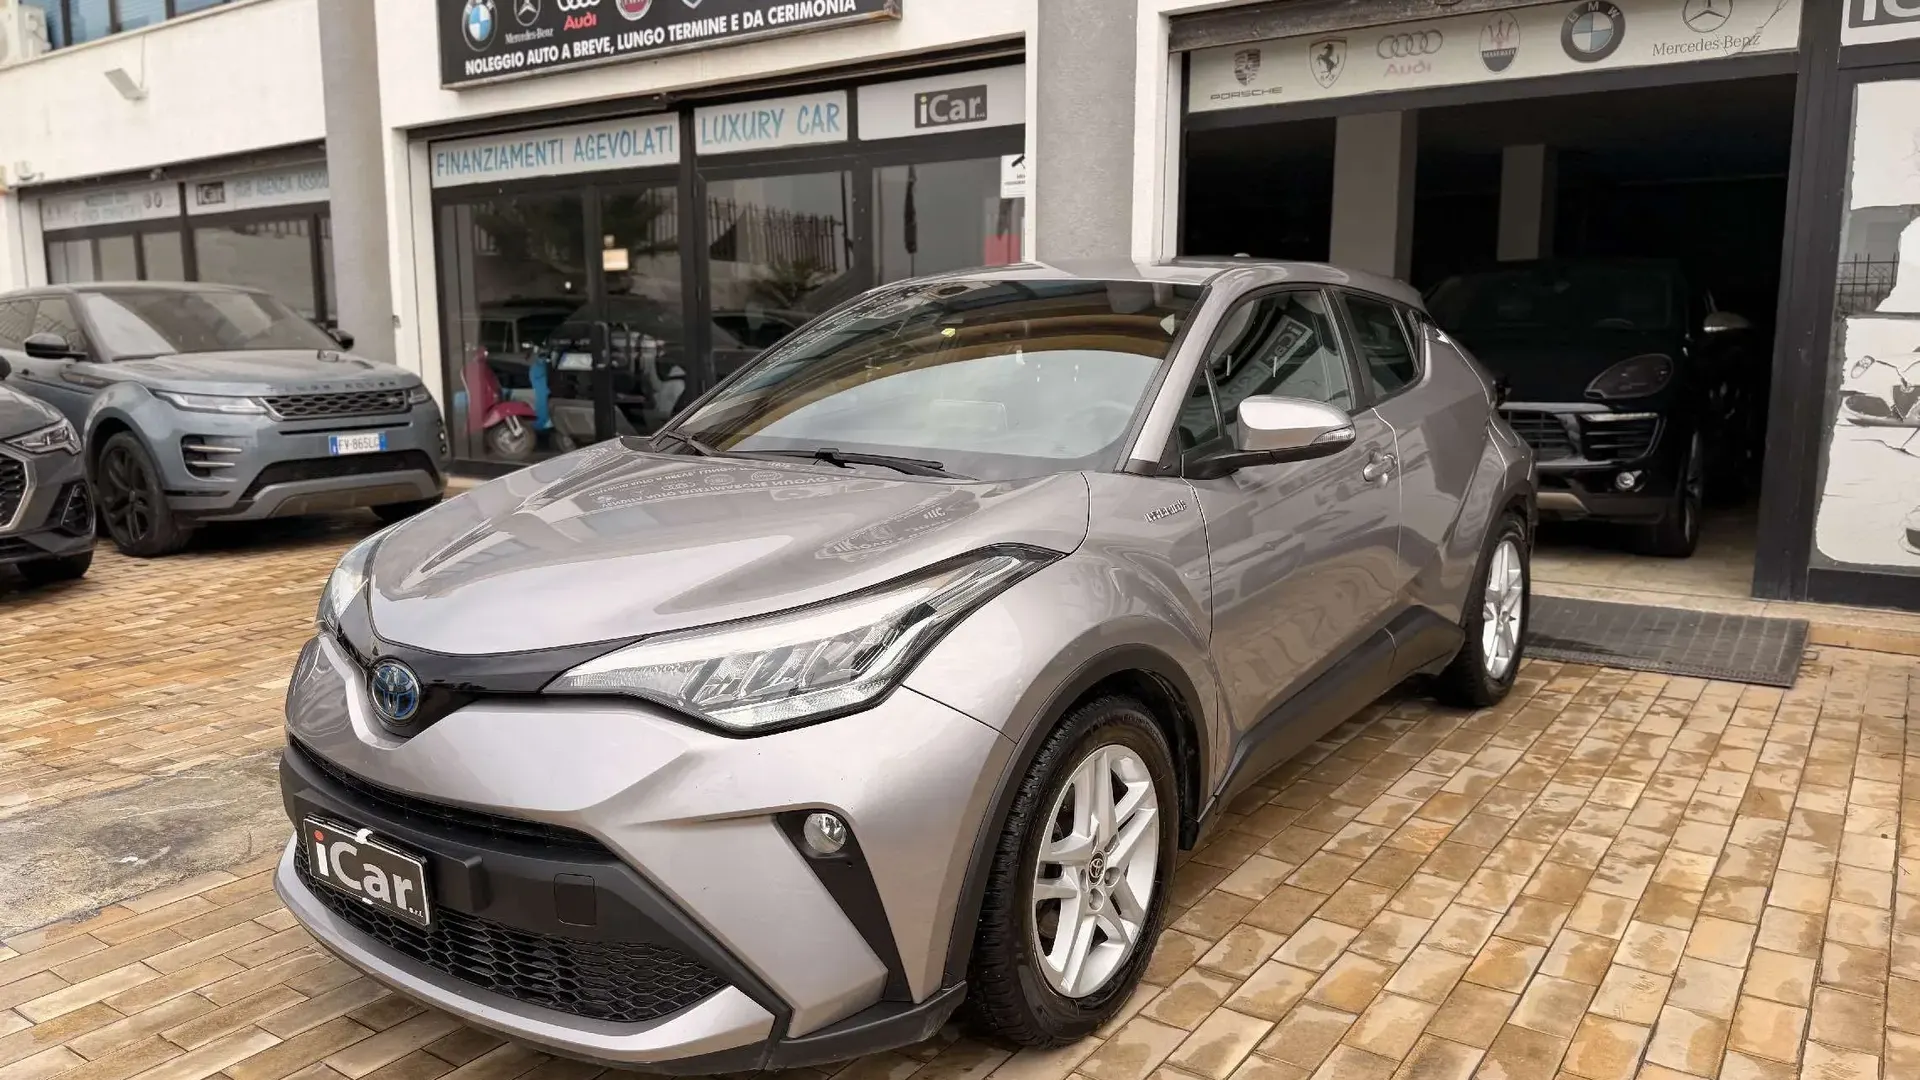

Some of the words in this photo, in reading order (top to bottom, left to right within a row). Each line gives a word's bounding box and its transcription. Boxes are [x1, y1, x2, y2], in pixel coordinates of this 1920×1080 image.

[505, 28, 554, 44] Mercedes-Benz
[563, 12, 597, 31] Audi
[465, 55, 524, 76] NOLEGGIO
[527, 47, 559, 65] AUTO
[562, 44, 571, 59] A
[573, 36, 615, 58] BREVE,
[618, 28, 665, 50] LUNGO
[668, 17, 727, 42] TERMINE
[731, 14, 739, 31] E
[743, 9, 764, 29] DA
[768, 0, 856, 25] CERIMONIA
[1383, 59, 1432, 78] Audi
[1211, 86, 1282, 100] PORSCHE
[701, 108, 785, 145] LUXURY
[797, 102, 840, 135] CAR
[920, 94, 982, 124] iCar
[437, 138, 564, 177] FINANZIAMENTI
[573, 125, 674, 162] AGEVOLATI
[314, 829, 413, 910] iCar
